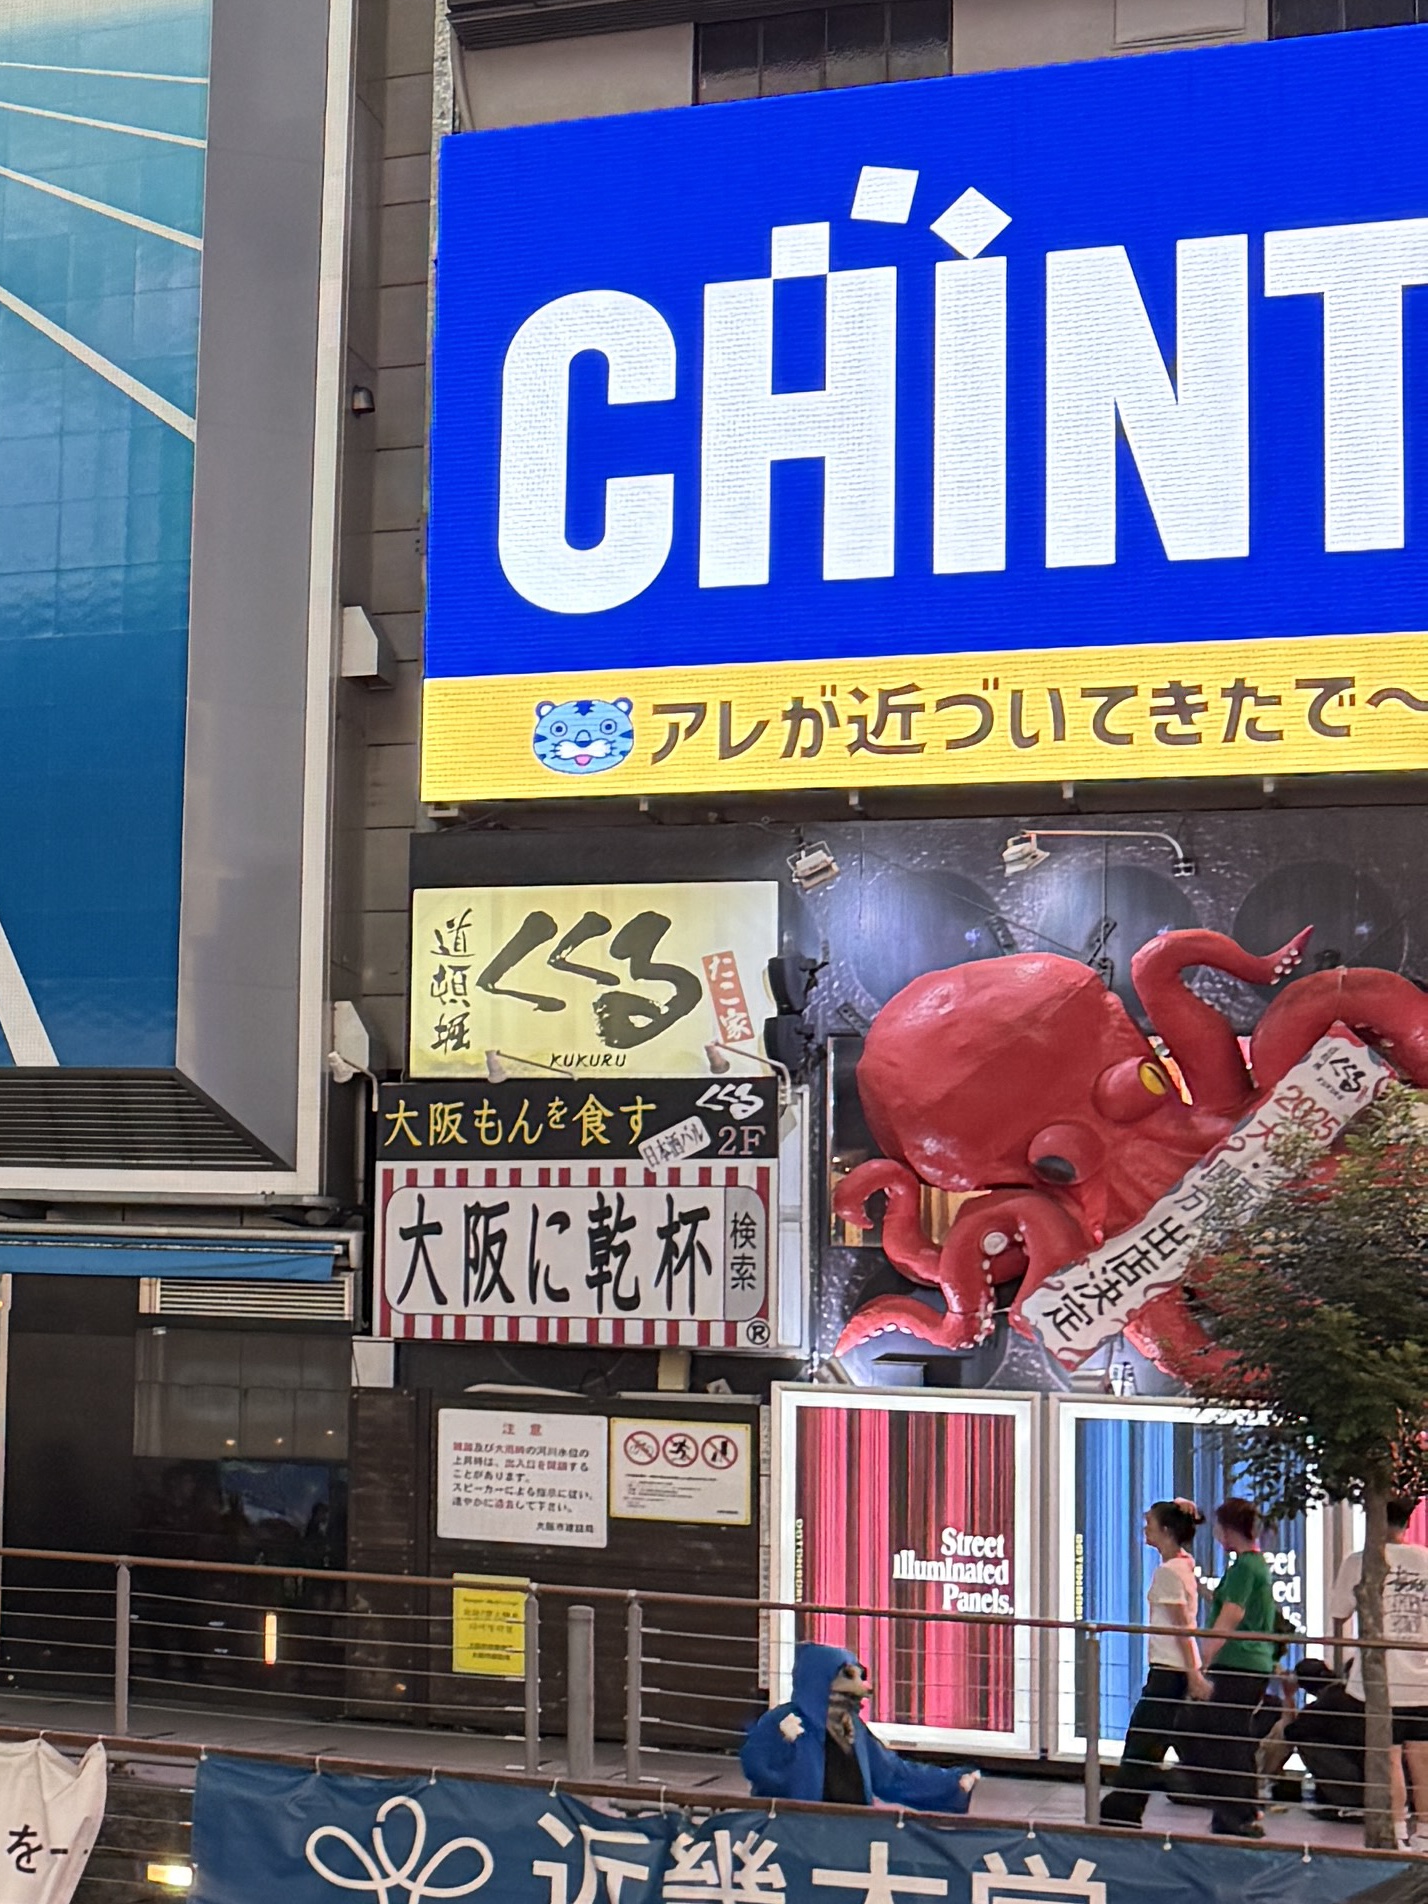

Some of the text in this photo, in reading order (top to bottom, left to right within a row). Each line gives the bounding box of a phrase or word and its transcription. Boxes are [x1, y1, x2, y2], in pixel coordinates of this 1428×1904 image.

[430, 907, 476, 1055] 道頓堀
[475, 910, 703, 1050] くくる
[549, 1052, 627, 1069] KUKURU
[383, 1092, 657, 1149] 大阪もんを食す
[695, 1082, 765, 1121] くくる
[1274, 1084, 1342, 1143] 2025
[643, 1122, 705, 1169] 日本酒バル
[717, 1125, 767, 1156] 2F
[396, 1190, 714, 1316] 大阪に乾杯
[729, 1210, 758, 1292] 検索
[1041, 1216, 1191, 1342] 出店決定
[941, 1526, 1005, 1559] Street
[942, 1582, 1015, 1615] Panels.
